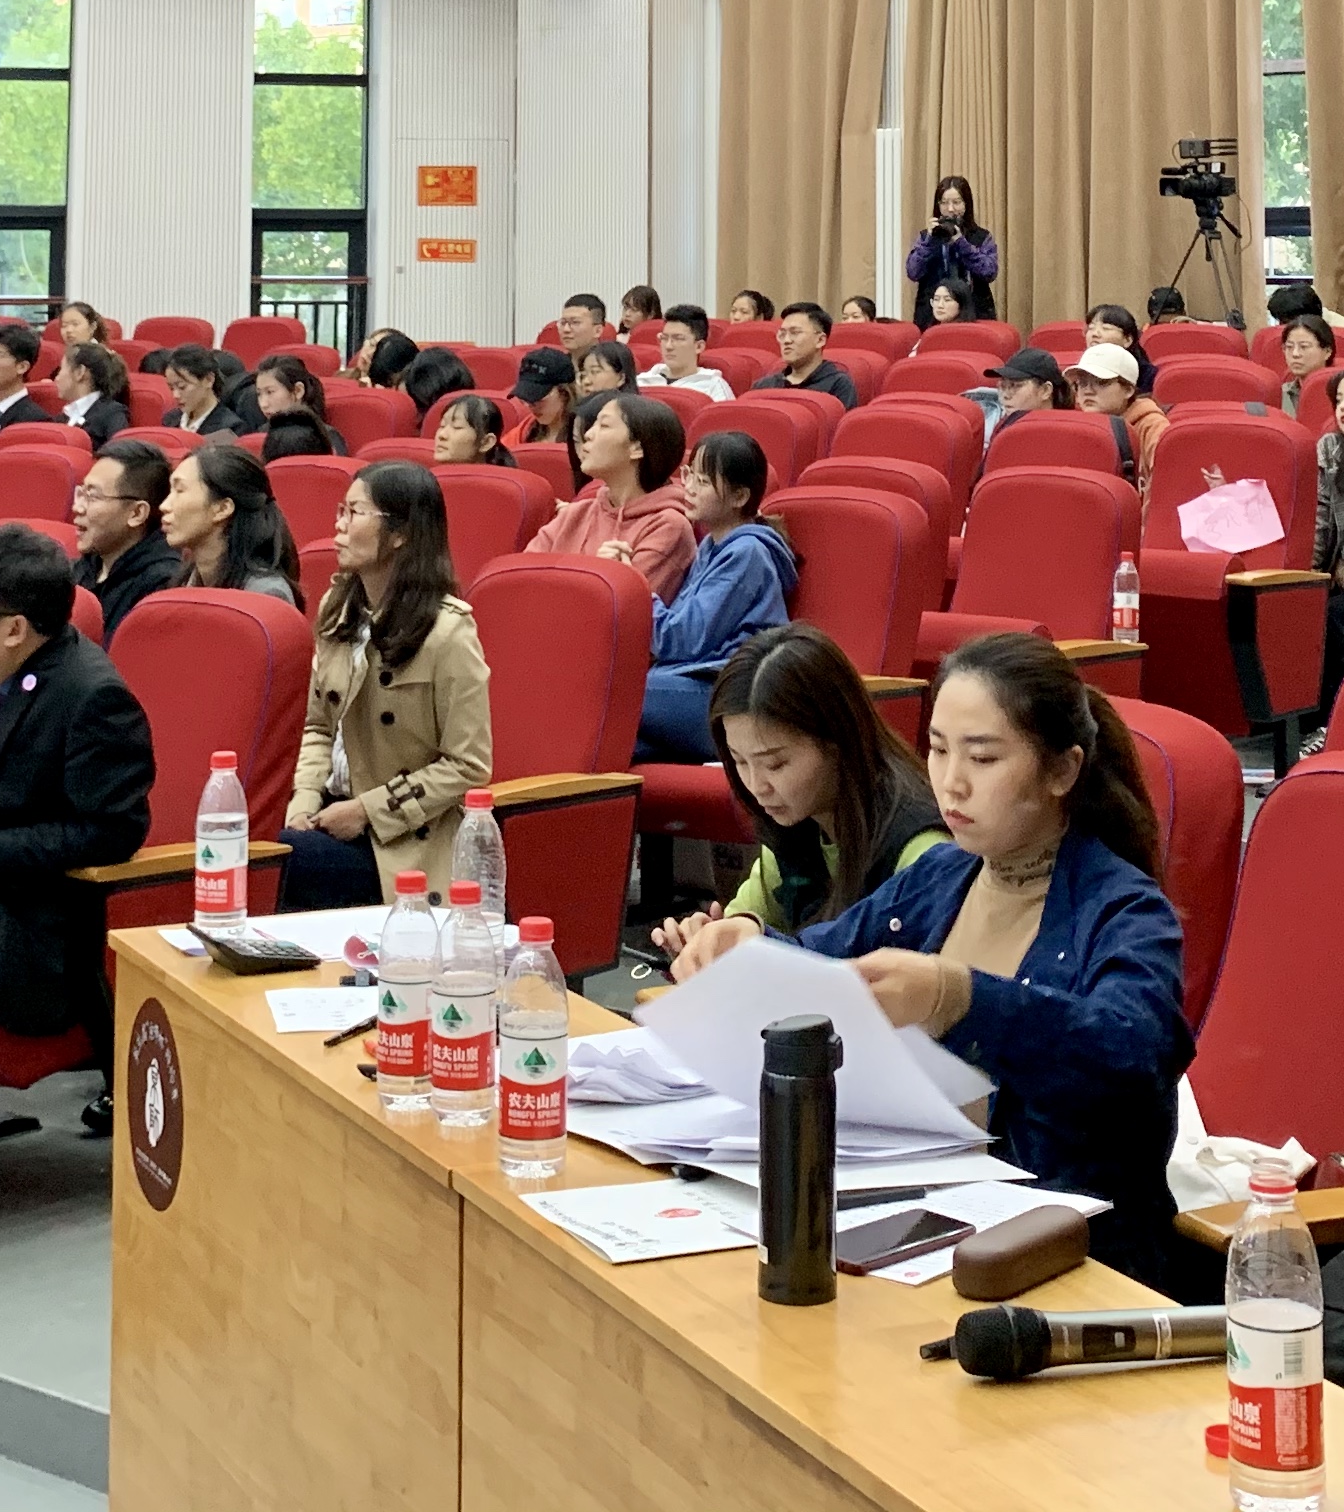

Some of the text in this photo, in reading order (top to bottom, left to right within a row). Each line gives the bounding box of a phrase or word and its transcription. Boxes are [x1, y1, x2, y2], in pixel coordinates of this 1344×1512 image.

[378, 1031, 413, 1048] 夫山泉
[508, 1091, 561, 1110] 农夫山泉
